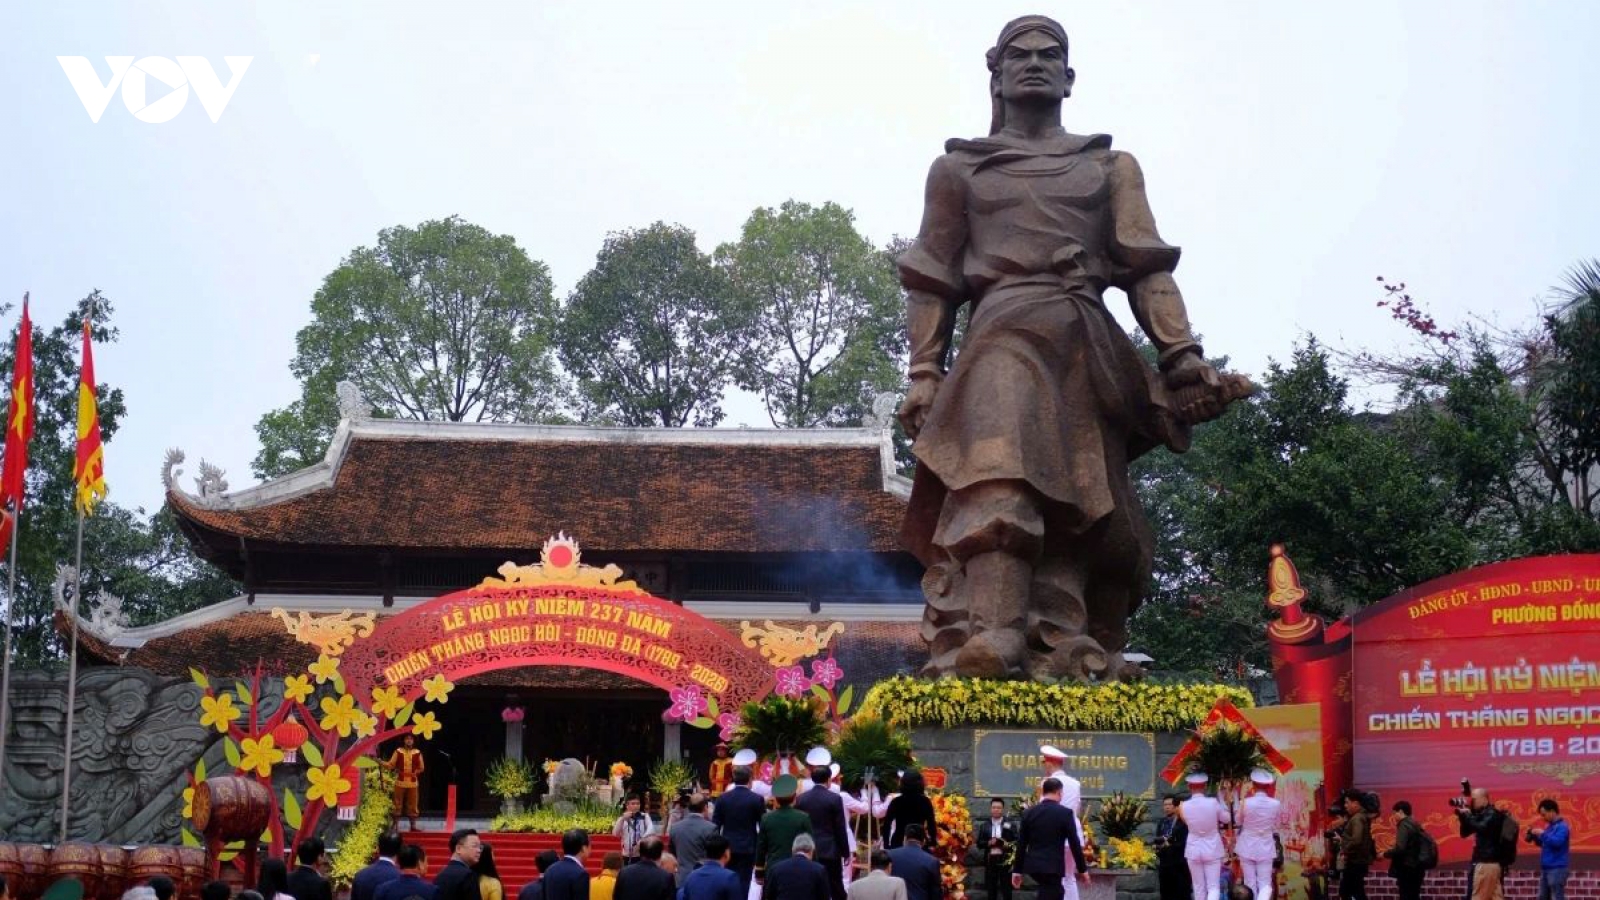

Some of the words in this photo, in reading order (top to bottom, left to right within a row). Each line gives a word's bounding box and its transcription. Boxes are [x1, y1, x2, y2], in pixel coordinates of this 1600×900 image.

[1408, 598, 1448, 618] ĐẢNG
[1450, 589, 1469, 606] ỦY
[1480, 584, 1521, 601] HĐND
[1532, 579, 1573, 594] UBND
[1492, 602, 1557, 624] PHƯỜNG
[469, 601, 501, 623] HỘI
[535, 596, 585, 618] NIỆM
[590, 603, 623, 622] 237
[627, 611, 673, 638] NĂM
[489, 625, 530, 646] NGỌC
[620, 634, 642, 656] ĐA
[645, 644, 681, 670] (1789
[690, 662, 729, 693] 2026)
[1401, 659, 1438, 696] LỄ
[1442, 661, 1489, 700] HỘI
[1493, 657, 1532, 692] KỶ
[1369, 705, 1440, 731] CHIẾN
[1445, 704, 1528, 728] THẮNG
[1067, 755, 1128, 770] TRUNG
[1491, 738, 1553, 757] (1789
